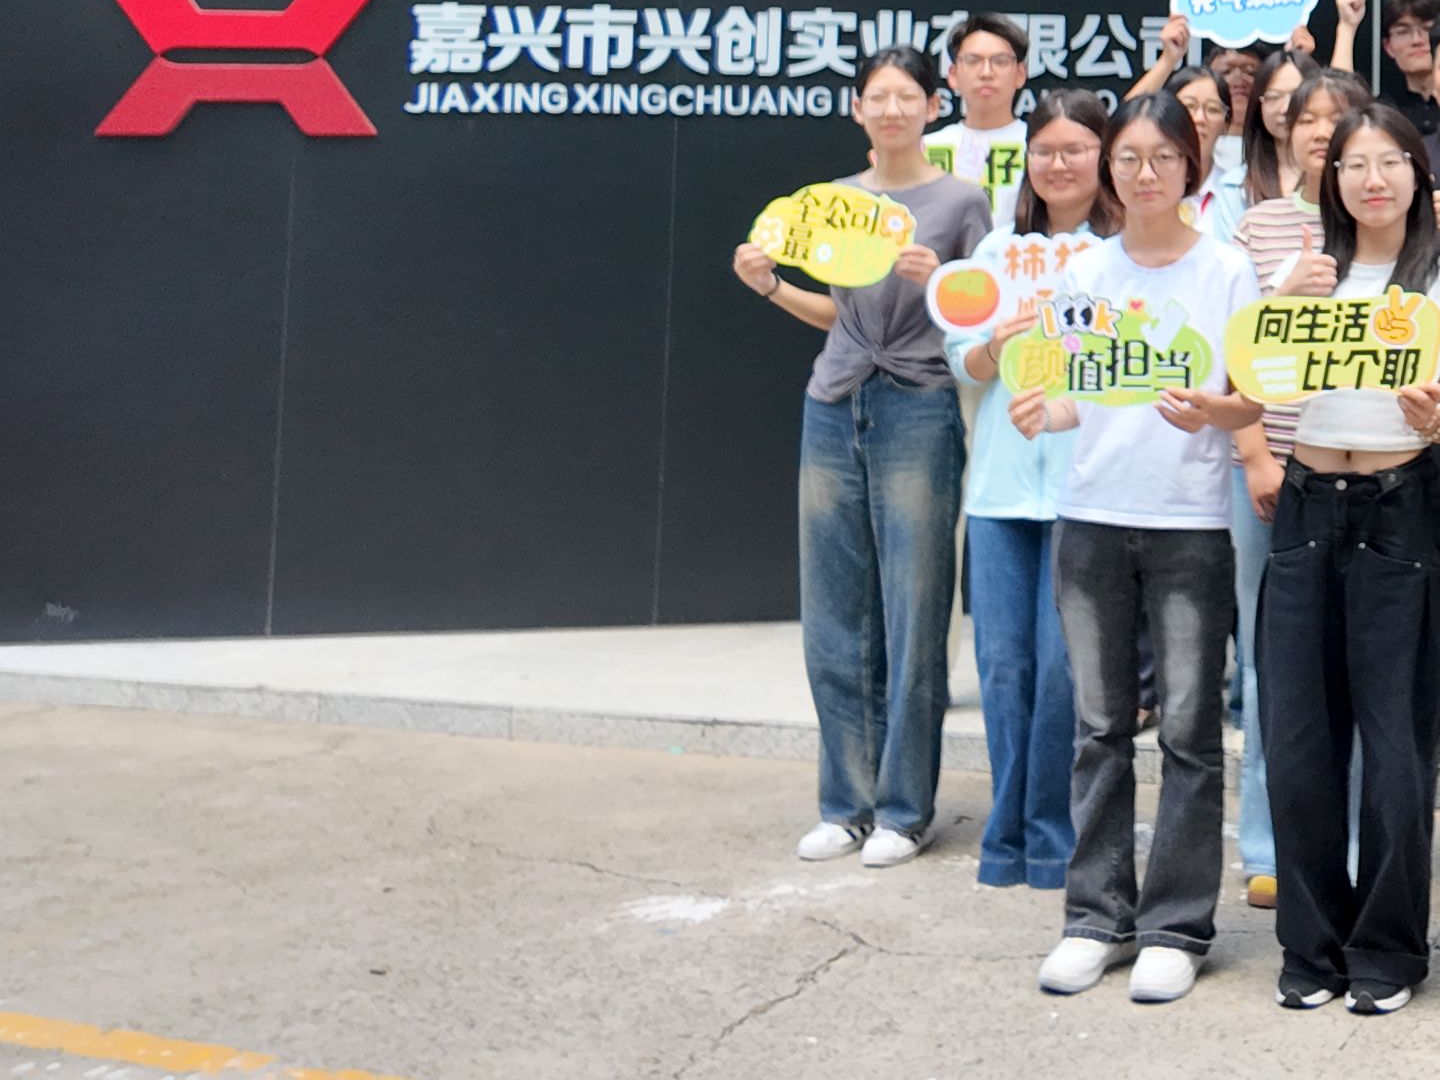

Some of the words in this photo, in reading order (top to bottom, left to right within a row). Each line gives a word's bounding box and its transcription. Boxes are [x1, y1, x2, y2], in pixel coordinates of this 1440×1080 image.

[403, 82, 568, 115] JIAXING
[571, 83, 838, 117] XINGCHUANG
[799, 187, 880, 235] 全公司
[782, 226, 813, 261] 最
[1253, 302, 1371, 344] 向生活
[1017, 337, 1193, 393] 颜值担当
[1301, 348, 1421, 391] 比个耶
